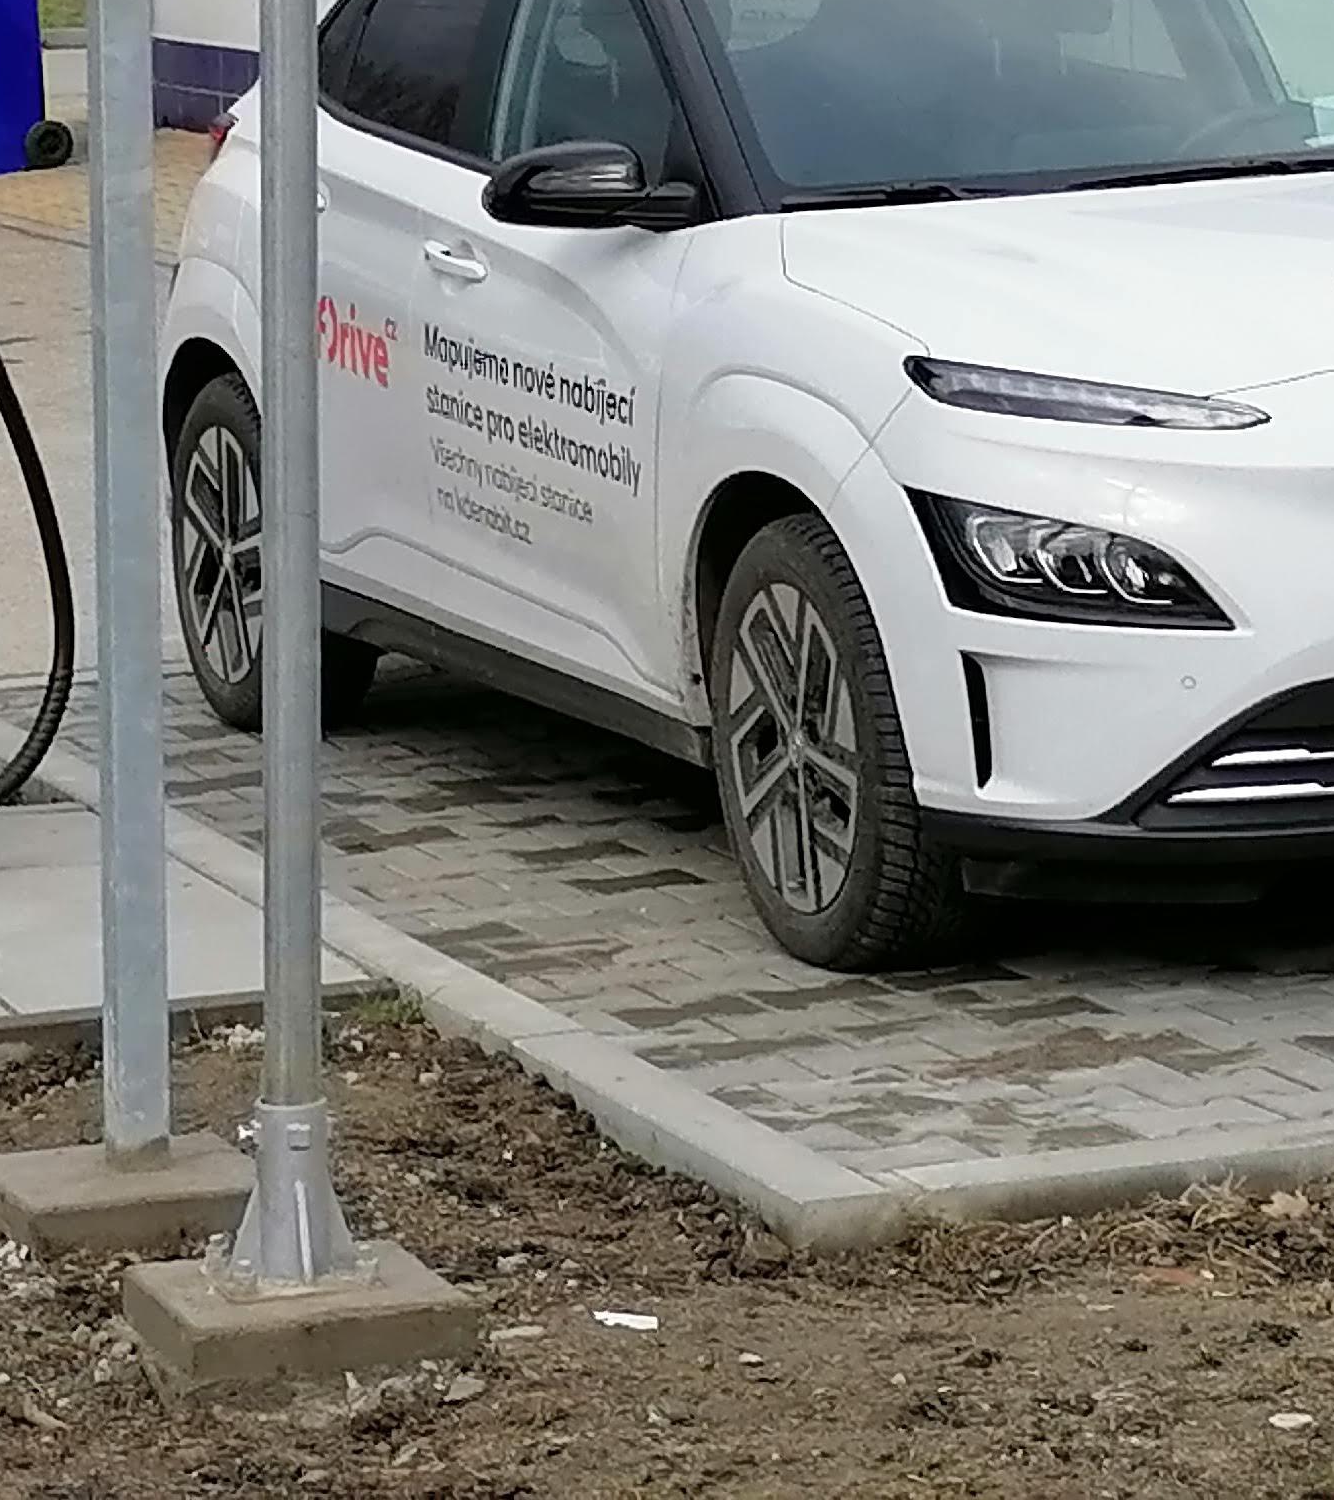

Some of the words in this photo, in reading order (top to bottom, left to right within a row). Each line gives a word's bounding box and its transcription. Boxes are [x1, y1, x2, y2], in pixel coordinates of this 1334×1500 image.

[424, 322, 510, 386] Mapujeme
[512, 361, 556, 400] nové
[558, 373, 637, 428] nabíjecí
[426, 384, 484, 433] stanice
[486, 408, 515, 445] pro
[518, 414, 642, 498] elektromobily
